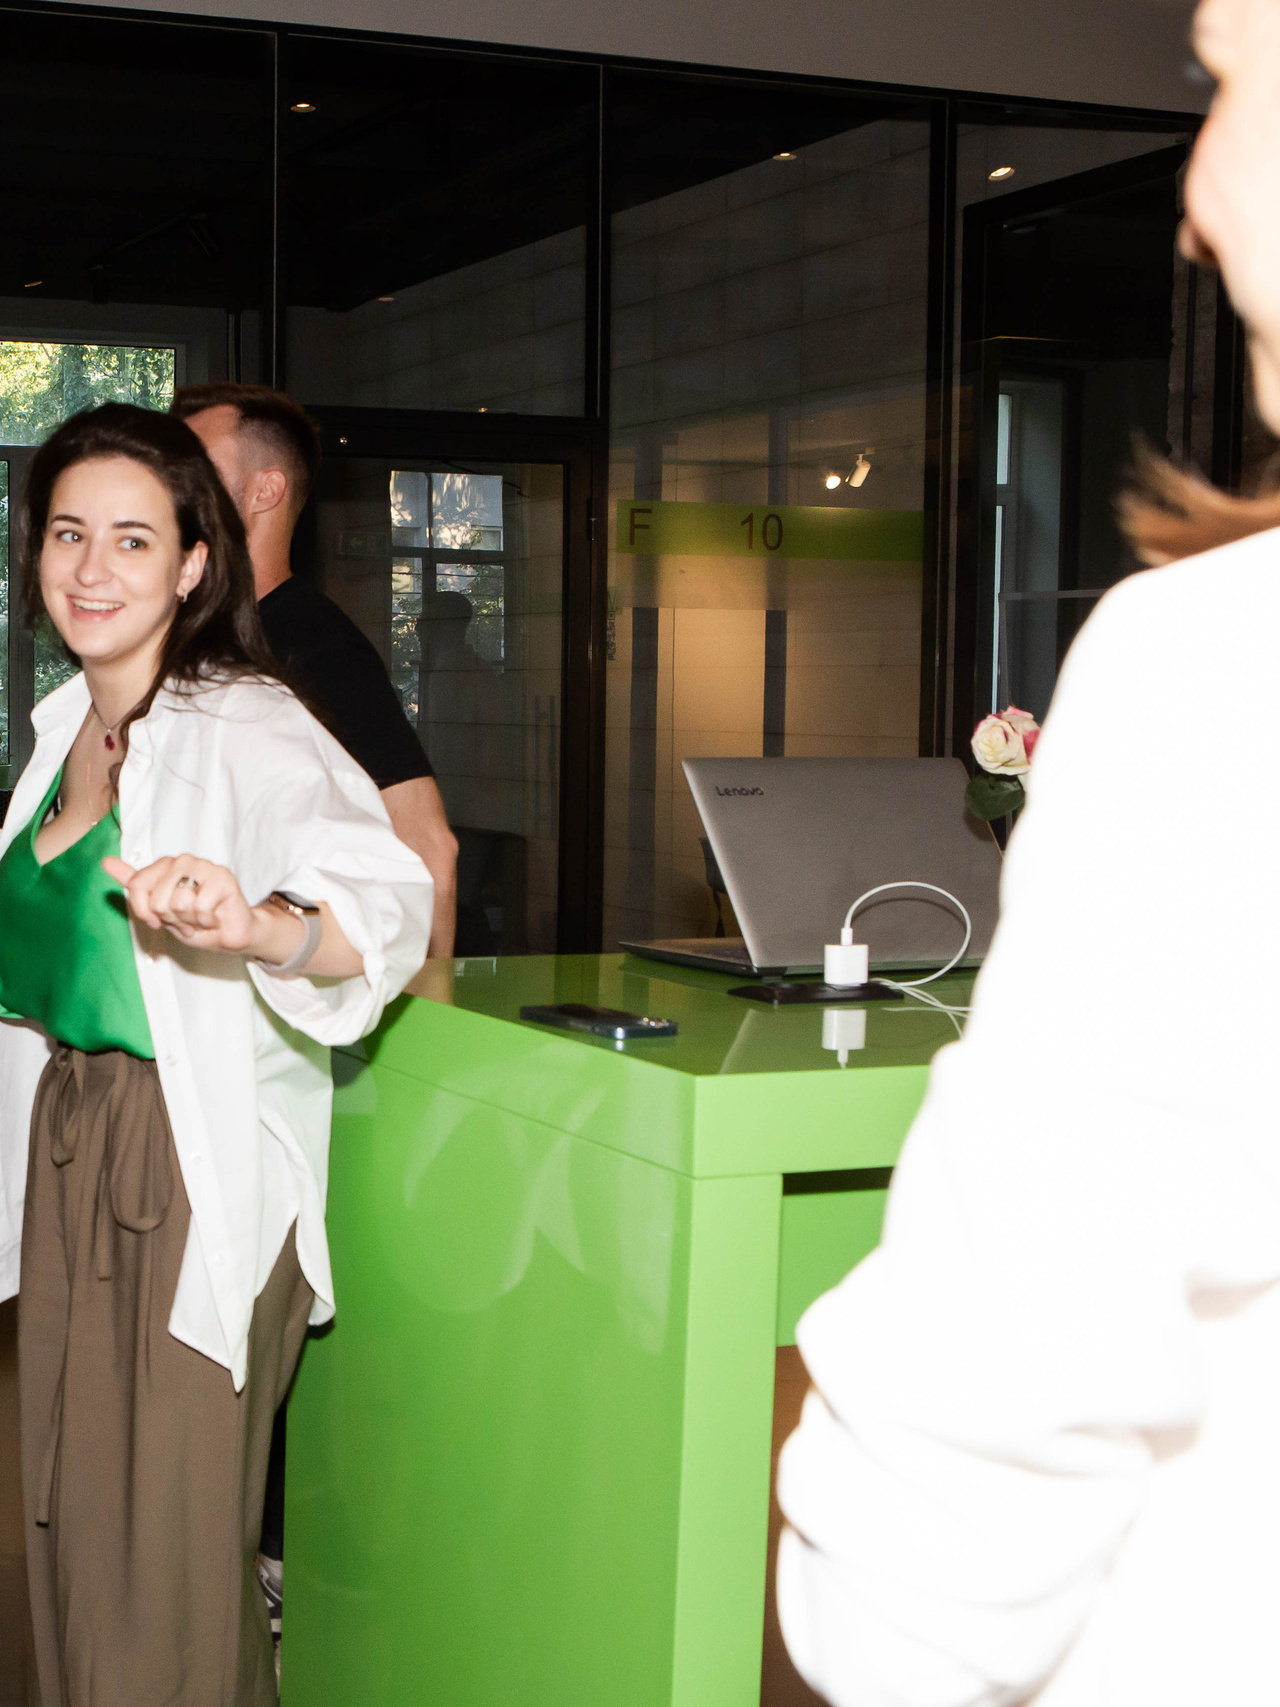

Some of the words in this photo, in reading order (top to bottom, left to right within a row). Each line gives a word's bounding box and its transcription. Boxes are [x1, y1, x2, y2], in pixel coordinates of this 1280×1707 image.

[630, 508, 652, 545] F
[740, 512, 783, 550] 10
[715, 786, 764, 796] Lenovo
